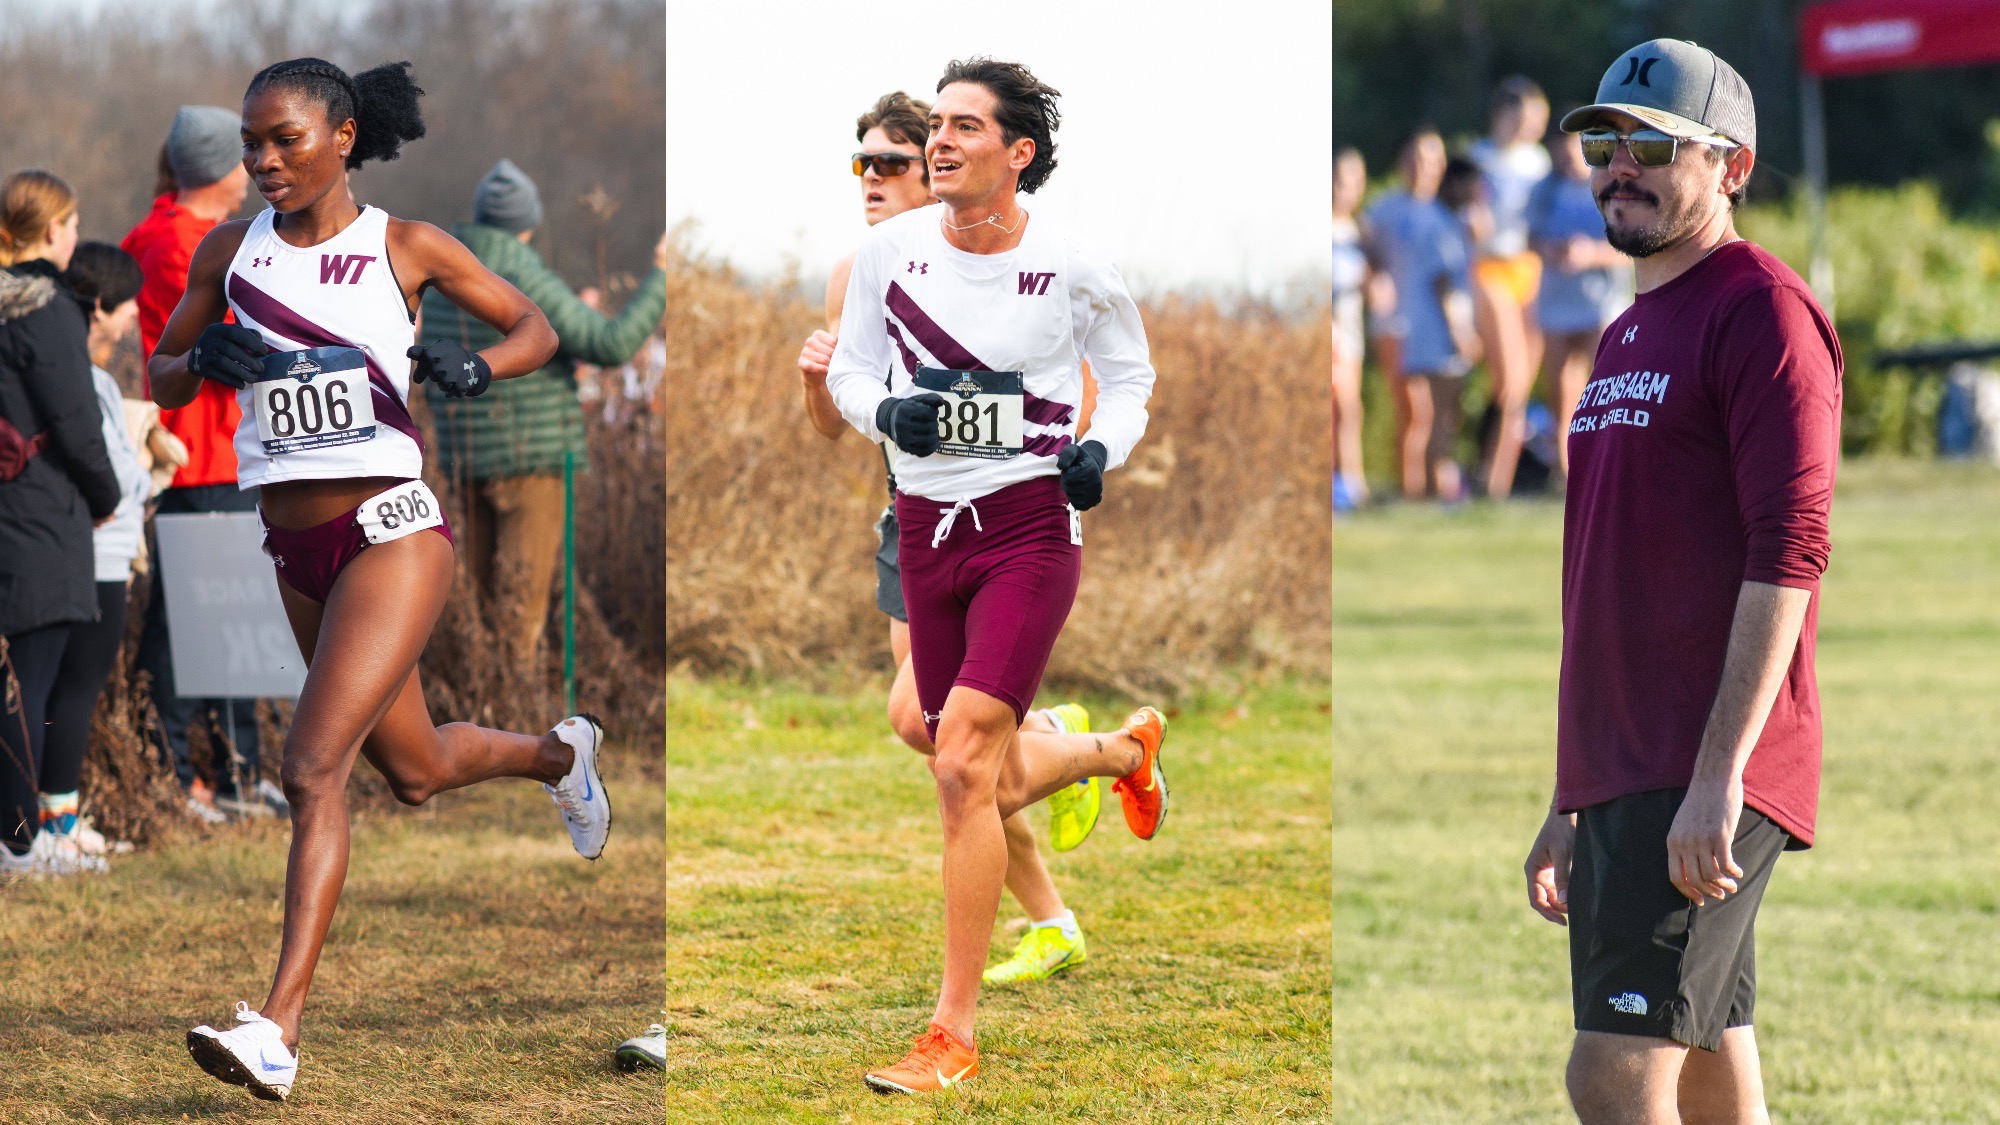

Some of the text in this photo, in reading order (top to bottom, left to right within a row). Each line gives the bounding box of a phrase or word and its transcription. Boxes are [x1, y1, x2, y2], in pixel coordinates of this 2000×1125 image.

[320, 254, 377, 284] WT
[1018, 272, 1056, 295] WT
[1576, 381, 1598, 411] ST
[1622, 370, 1670, 404] A&M
[268, 380, 353, 437] 806
[1569, 415, 1598, 435] ACK
[1606, 408, 1650, 428] FIELD
[939, 400, 1003, 446] 381
[376, 489, 430, 530] 806
[1608, 996, 1636, 1008] NORTH
[1614, 1003, 1634, 1014] FACE
[1622, 992, 1636, 1001] THE
